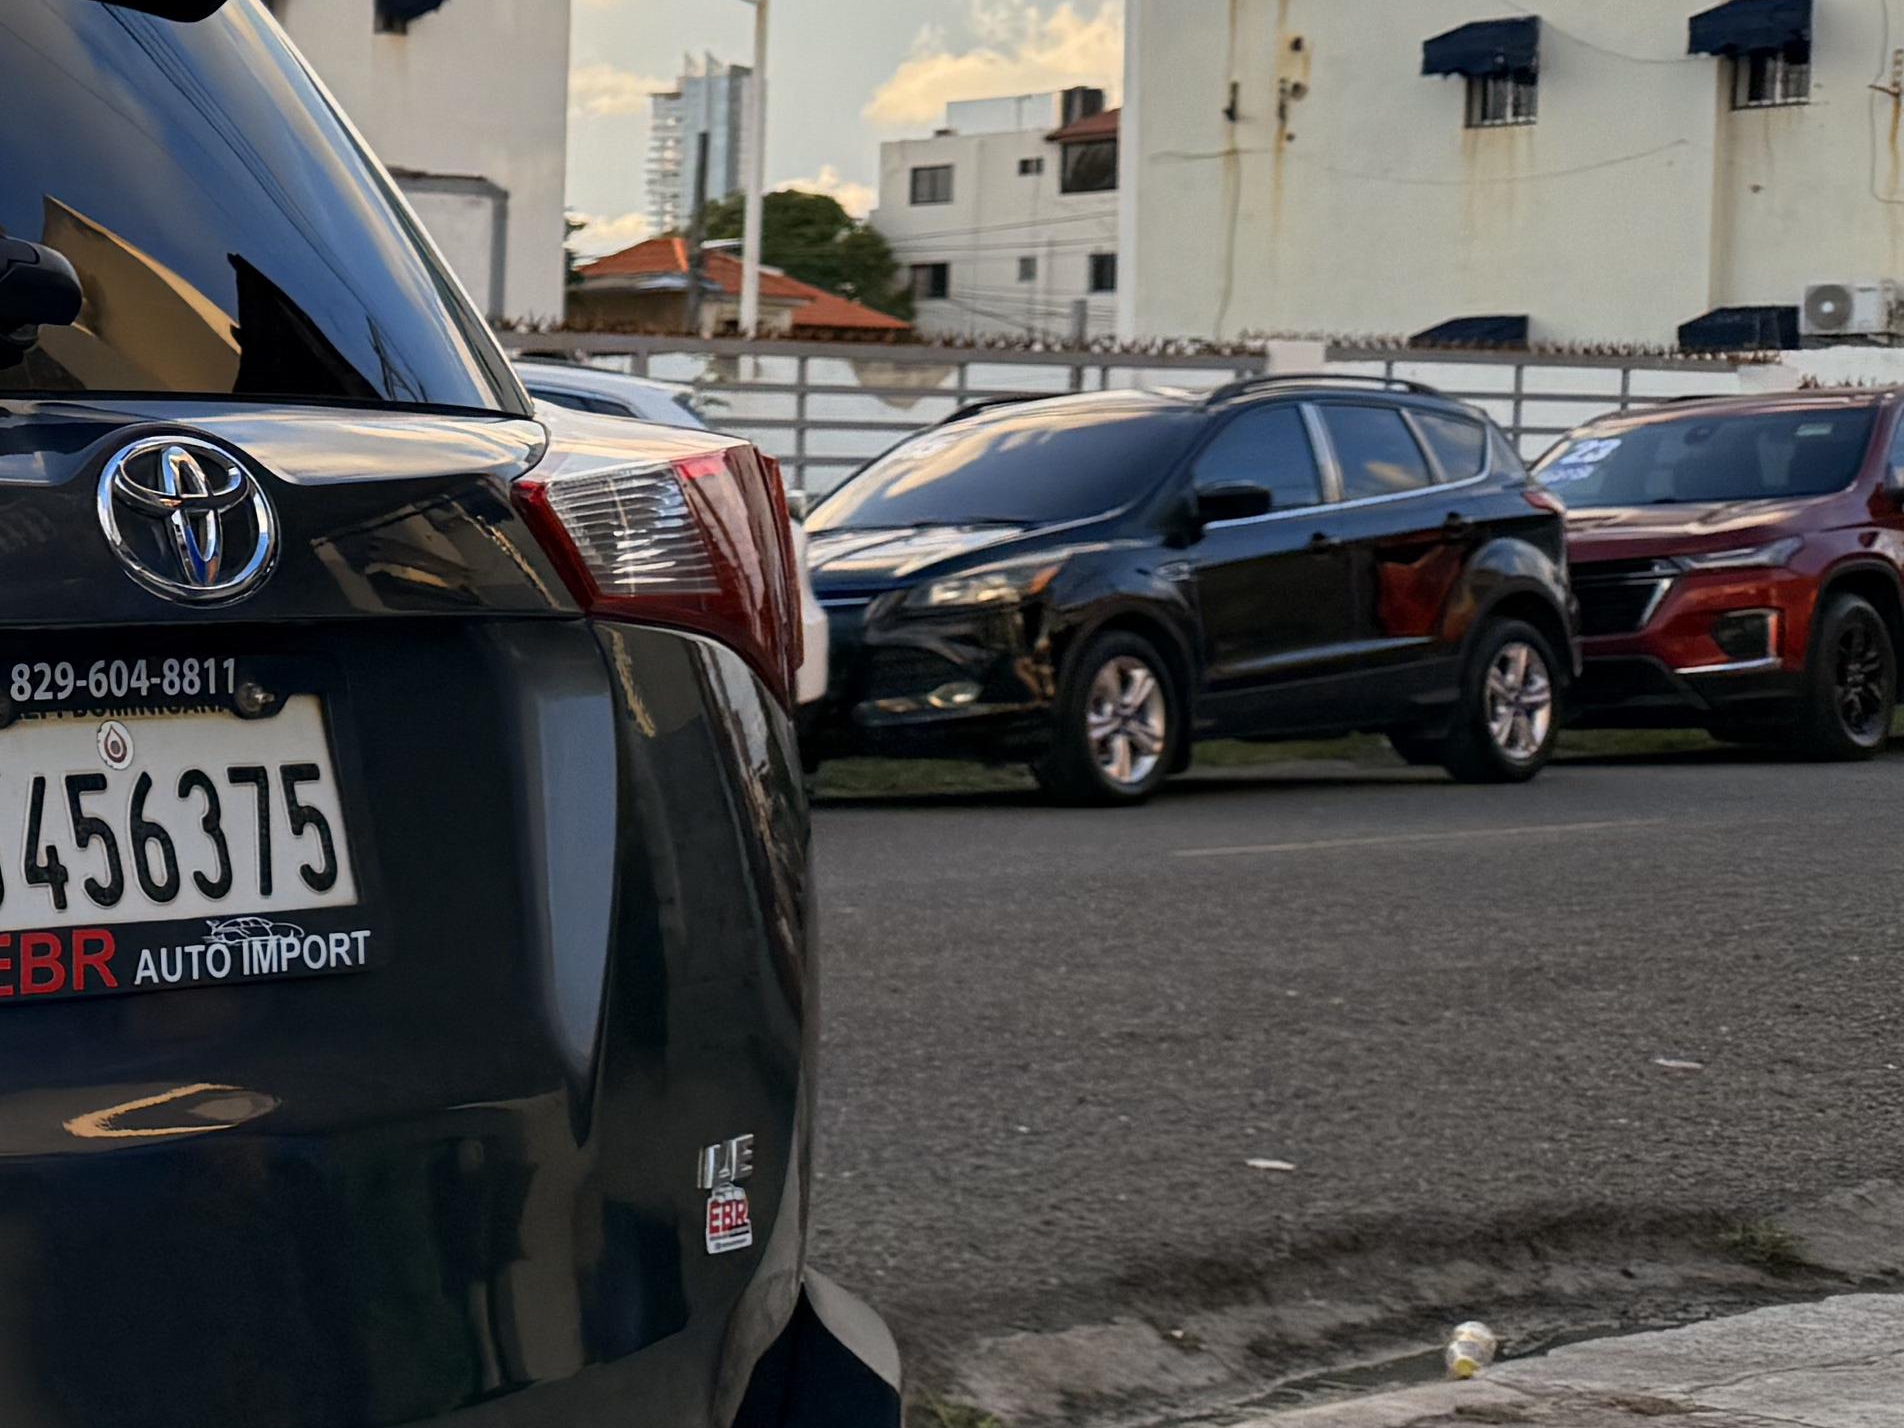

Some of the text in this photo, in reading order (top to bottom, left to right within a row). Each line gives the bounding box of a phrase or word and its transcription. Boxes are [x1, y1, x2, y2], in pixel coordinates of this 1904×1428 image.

[10, 657, 235, 702] 829-604-8811
[134, 944, 231, 985] AUTO
[242, 931, 371, 975] IMPORT
[708, 1200, 747, 1234] EBR
